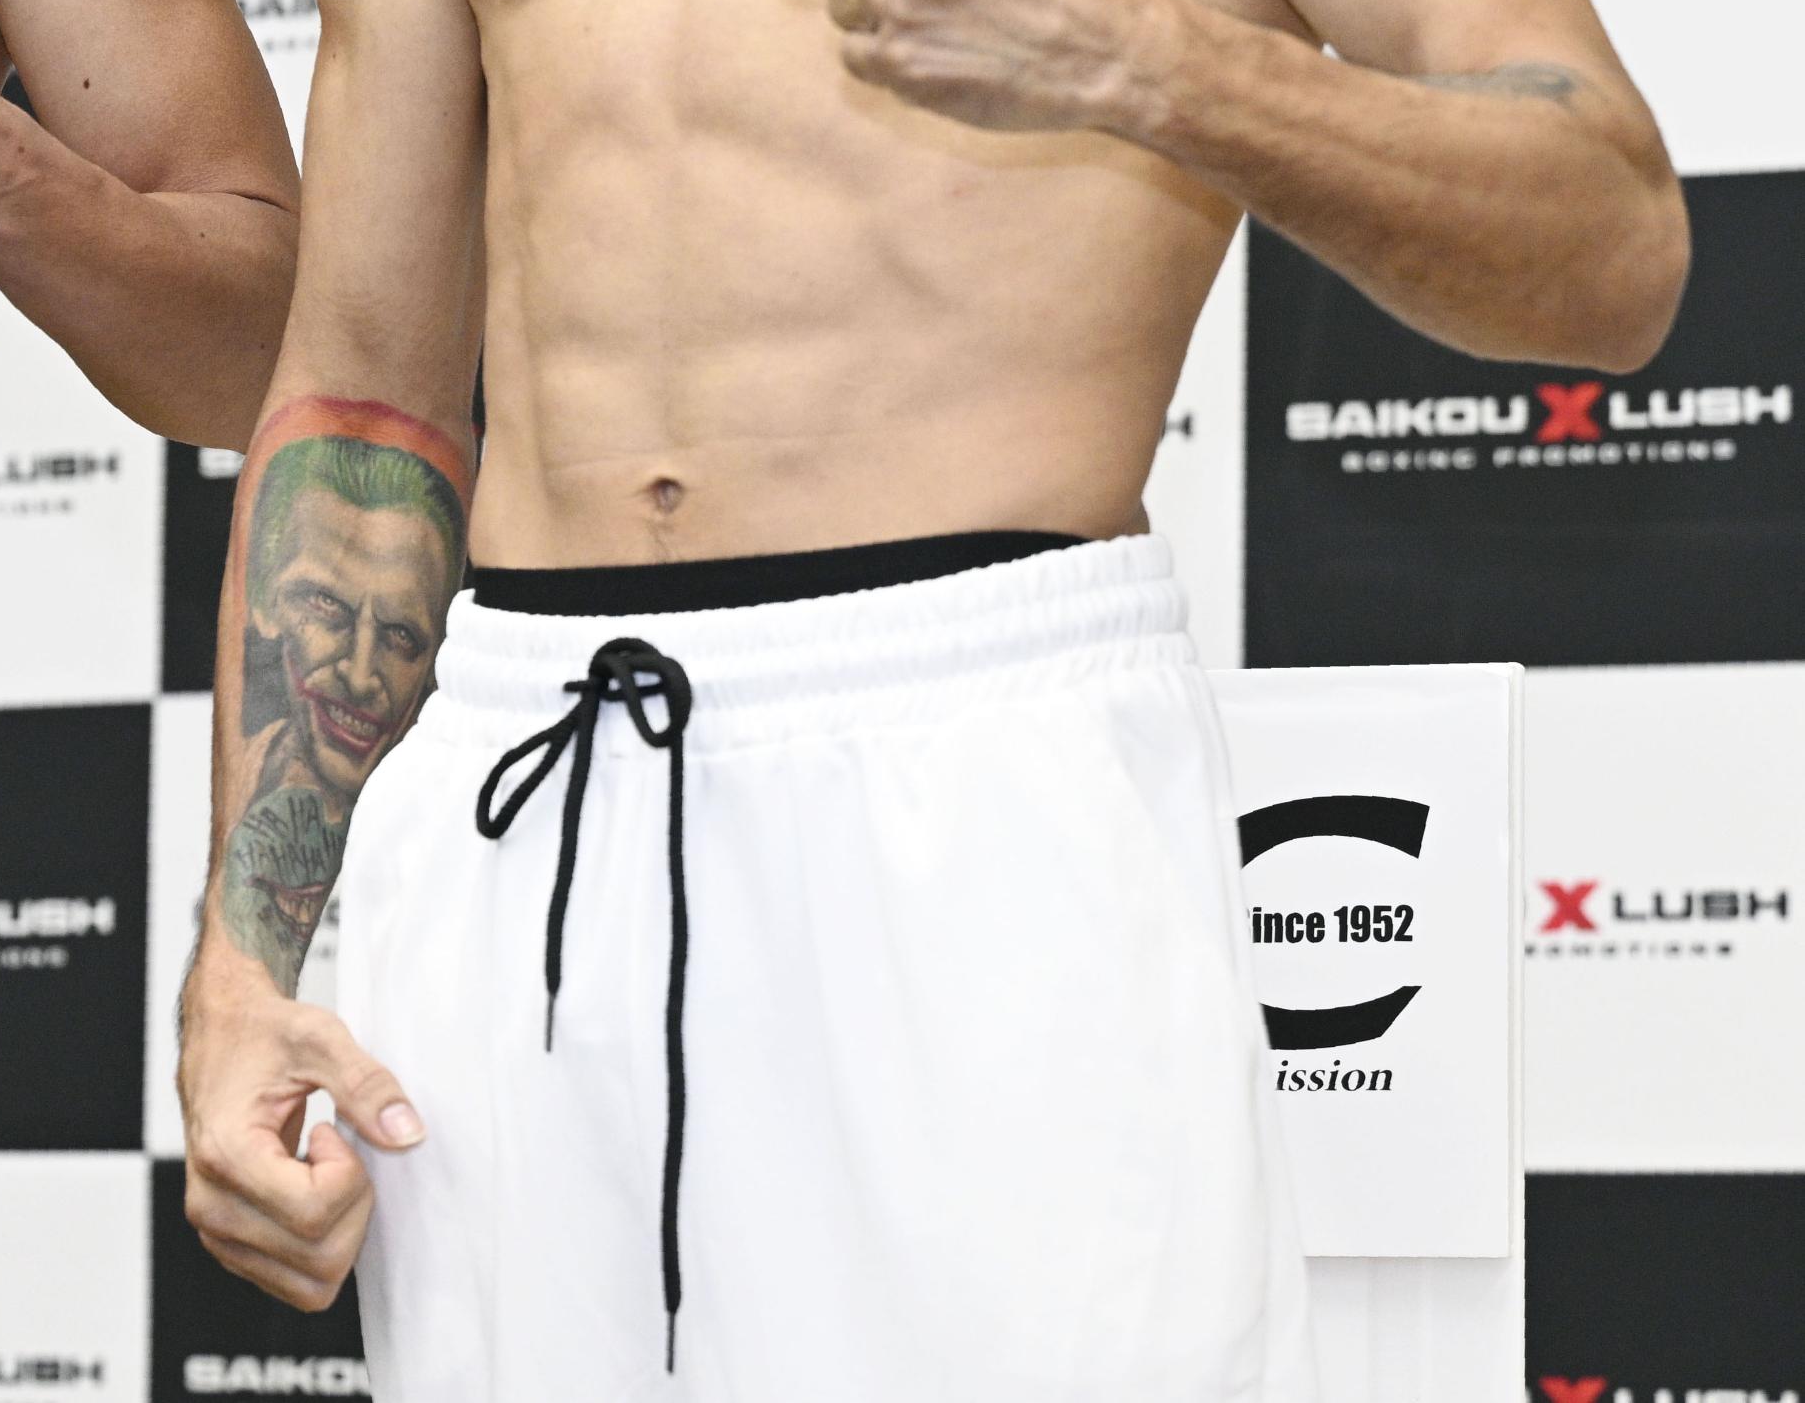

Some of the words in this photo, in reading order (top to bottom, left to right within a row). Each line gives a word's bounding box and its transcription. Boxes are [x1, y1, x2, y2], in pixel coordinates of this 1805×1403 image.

[1286, 396, 1529, 441] SAIKOU
[1535, 382, 1604, 444] X
[1609, 385, 1792, 430] LUSH
[1247, 906, 1326, 944] ince
[1333, 905, 1415, 943] 1952
[1538, 881, 1599, 935] X
[1613, 889, 1789, 921] LUSH
[1275, 1060, 1393, 1092] ission
